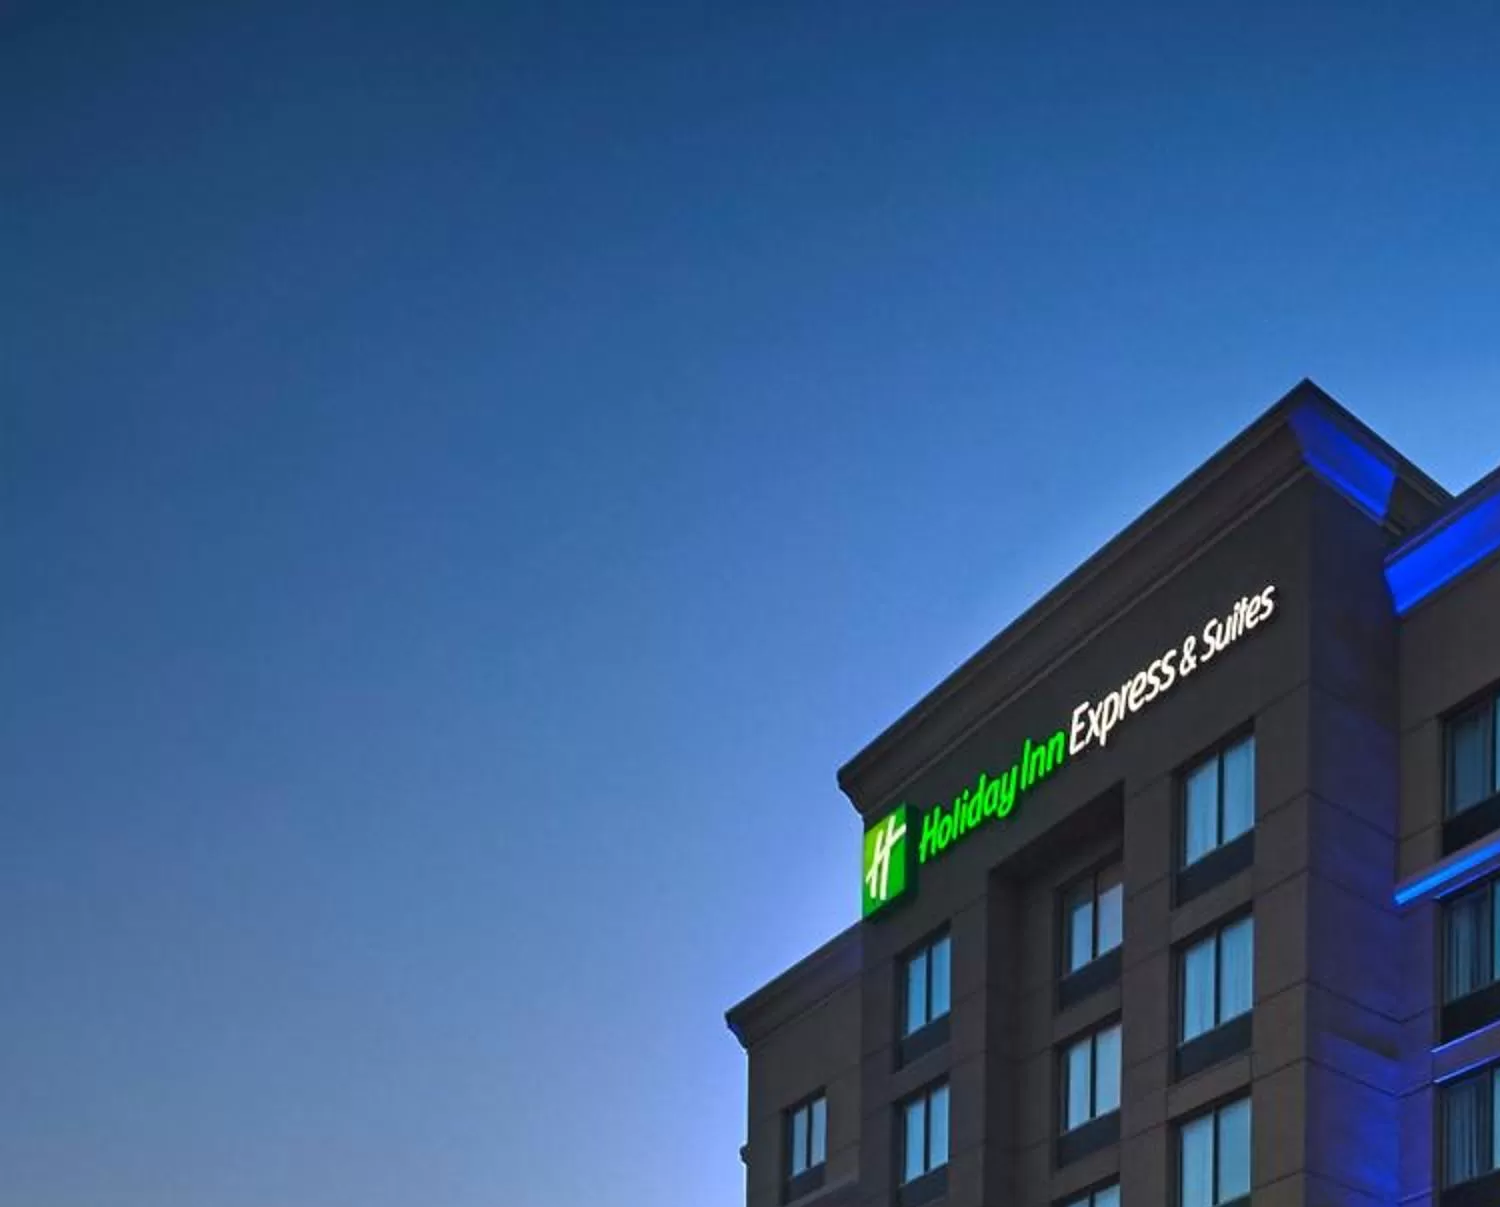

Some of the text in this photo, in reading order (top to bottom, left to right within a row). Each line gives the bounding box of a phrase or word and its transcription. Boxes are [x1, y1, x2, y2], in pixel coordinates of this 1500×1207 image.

[919, 585, 1275, 864] Holiday Inn Express & Suites
